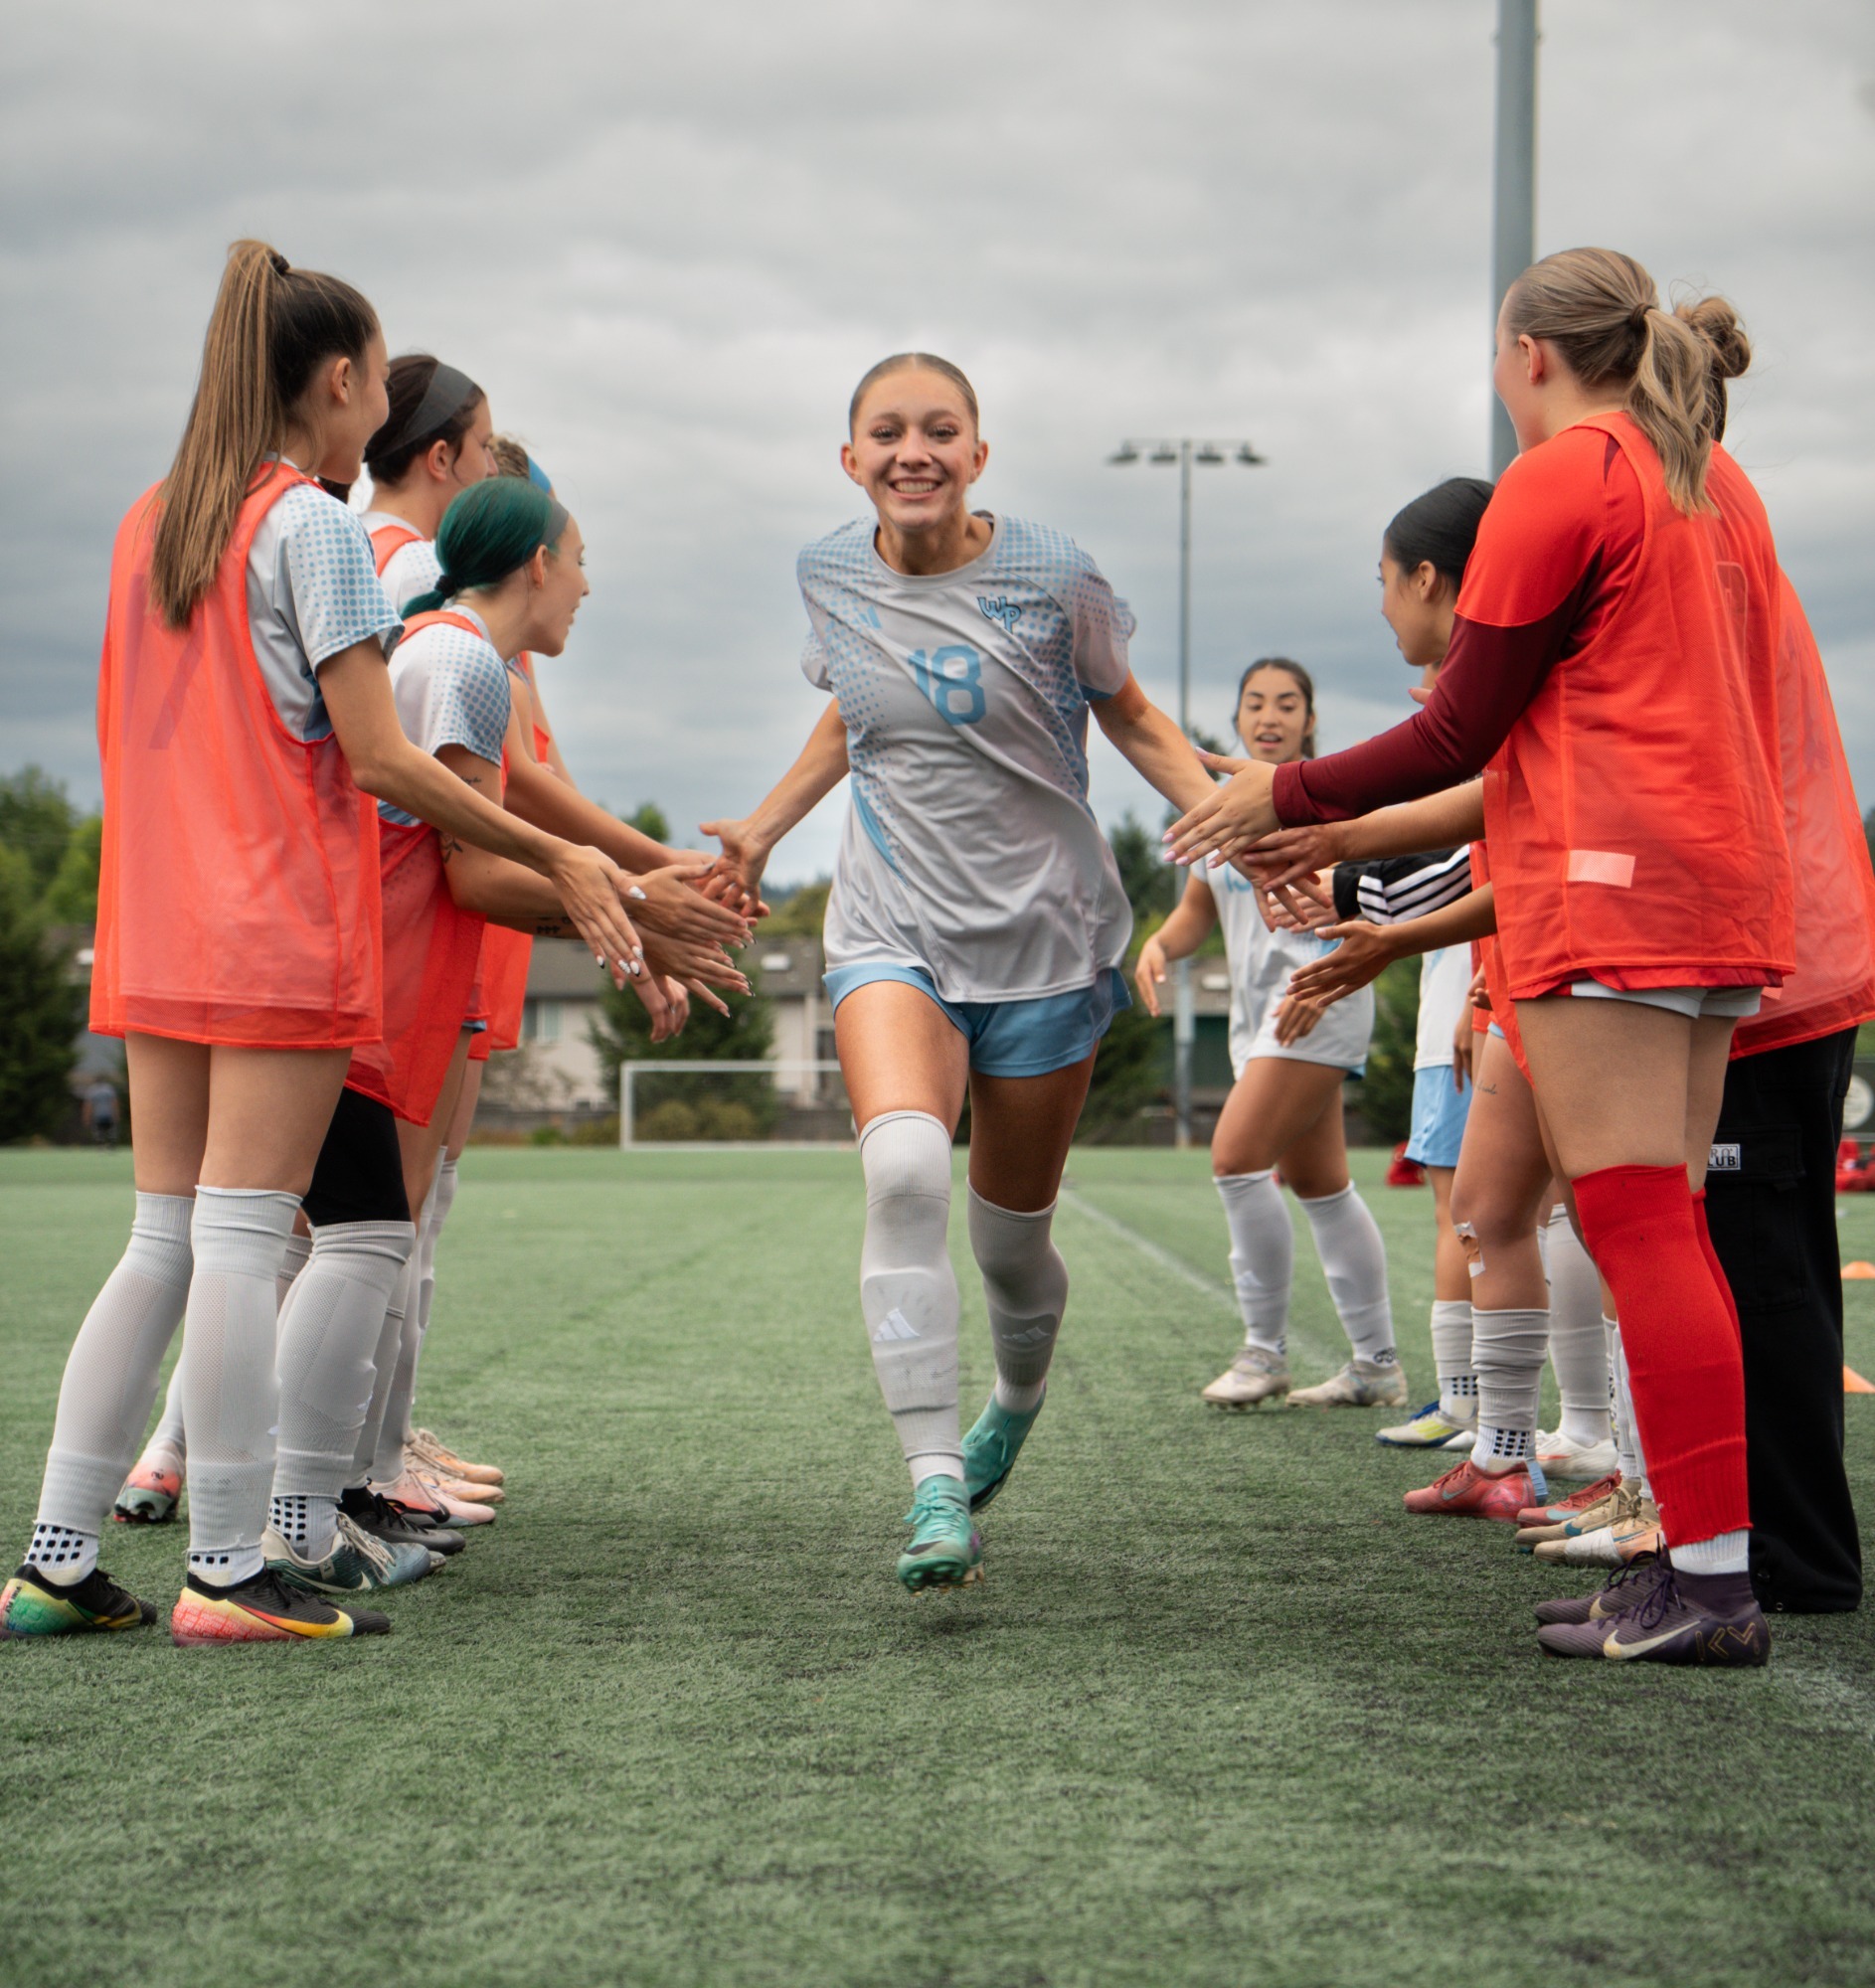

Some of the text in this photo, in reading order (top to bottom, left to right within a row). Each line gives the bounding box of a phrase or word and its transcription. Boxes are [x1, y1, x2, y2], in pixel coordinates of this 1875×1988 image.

[977, 596, 1021, 634] WP
[908, 645, 986, 726] 18
[1708, 1156, 1736, 1166] LUB
[1710, 1148, 1730, 1158] RO
